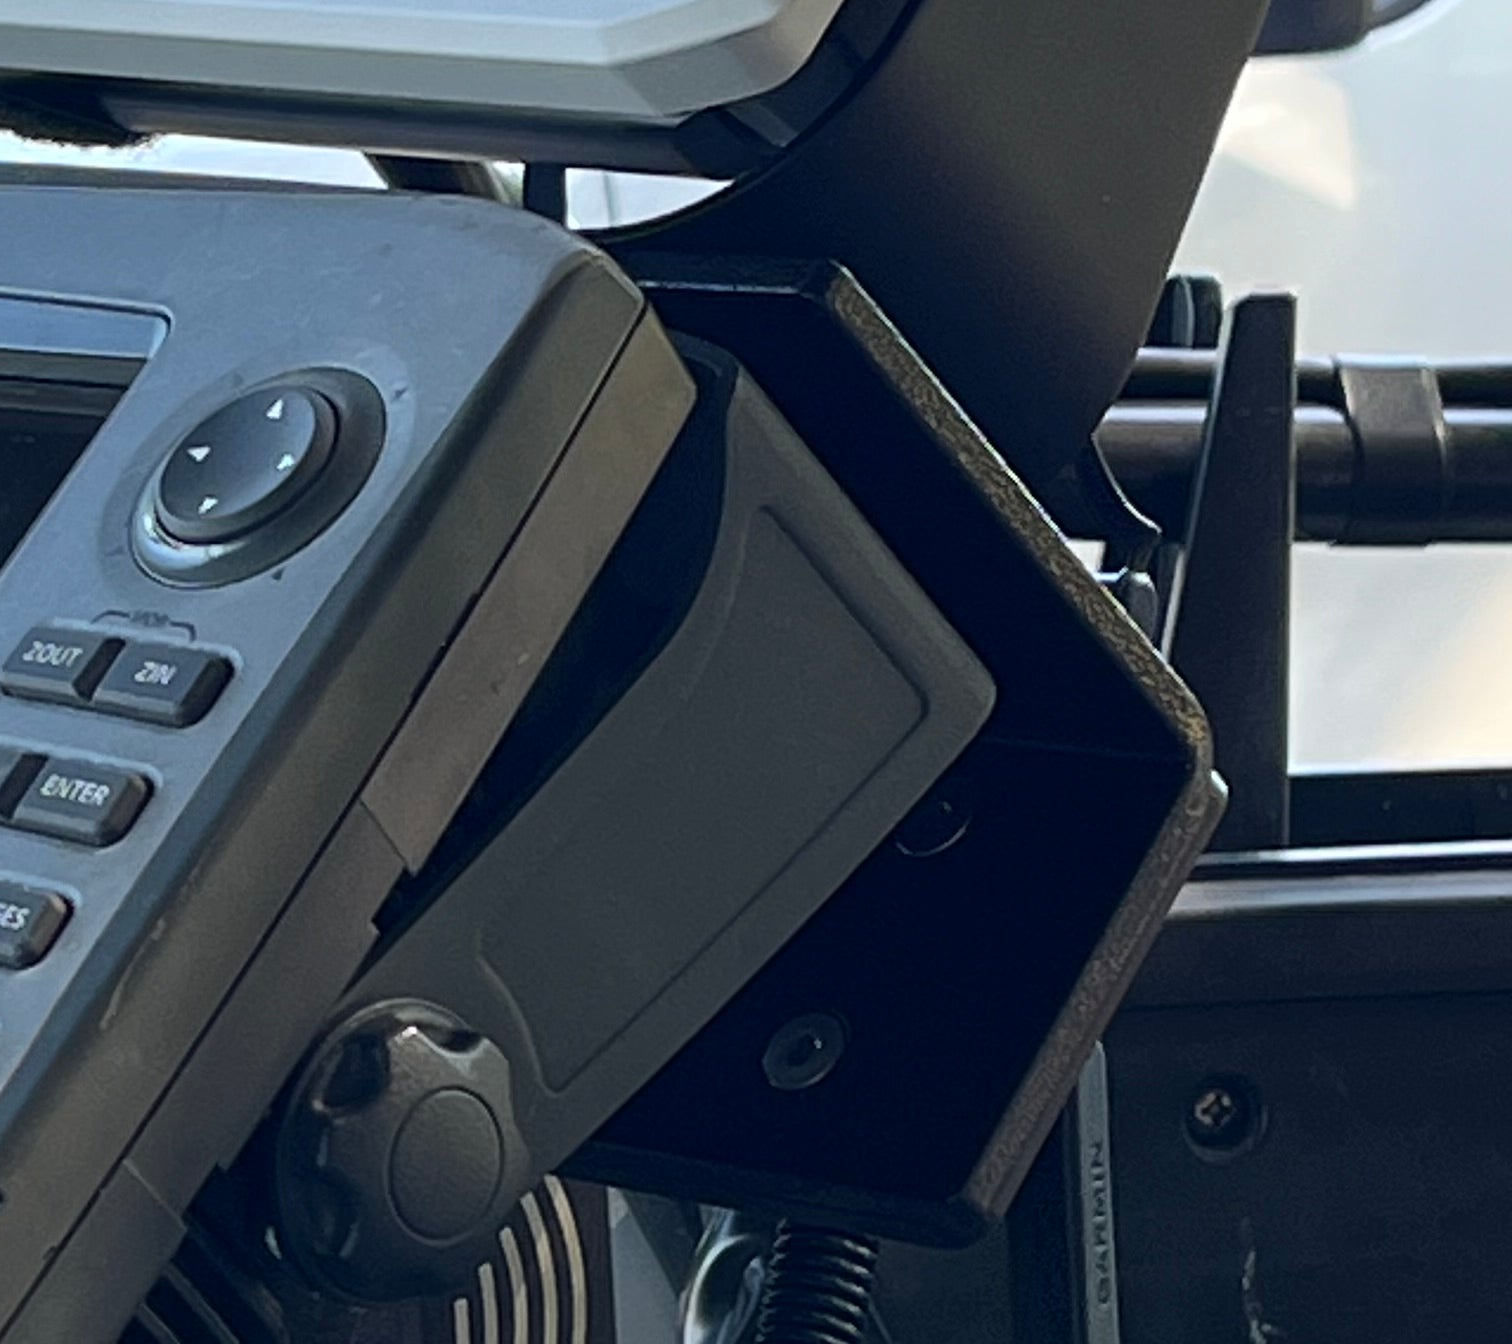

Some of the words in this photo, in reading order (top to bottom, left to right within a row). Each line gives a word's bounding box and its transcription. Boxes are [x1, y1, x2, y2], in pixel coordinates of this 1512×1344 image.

[22, 640, 83, 668] ZOUT
[133, 661, 177, 686] ZIN
[39, 773, 111, 807] ENTER
